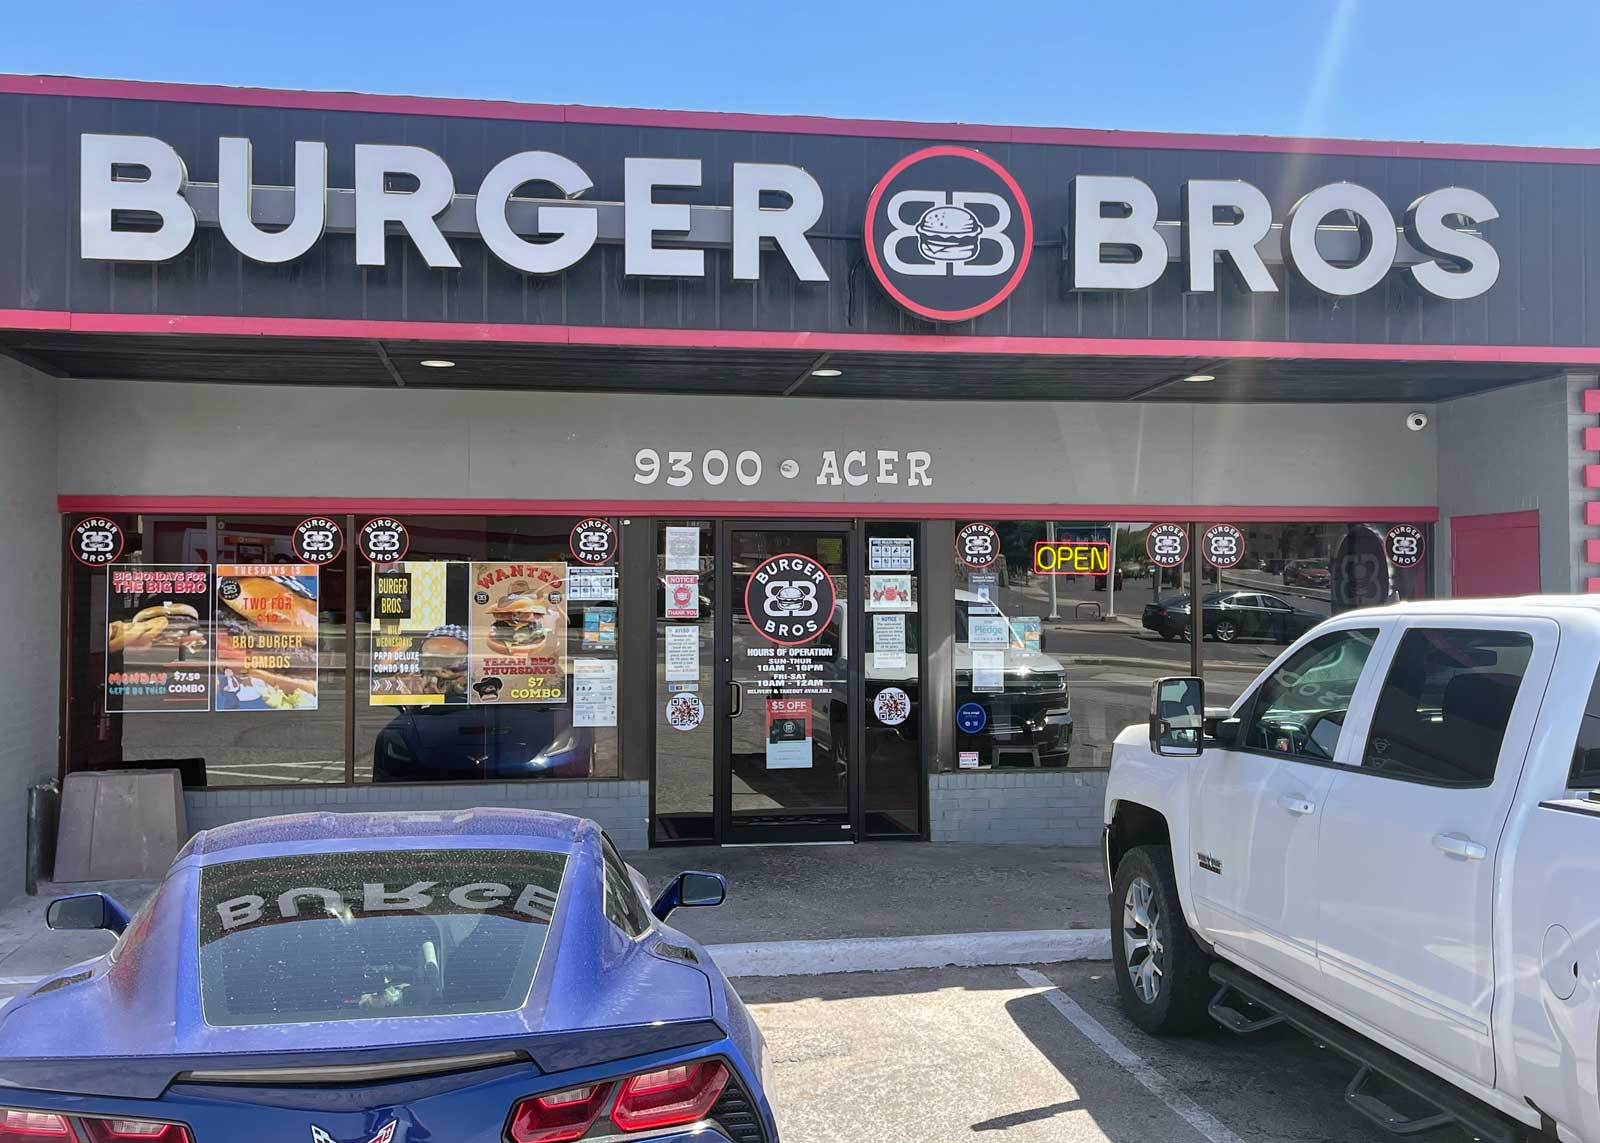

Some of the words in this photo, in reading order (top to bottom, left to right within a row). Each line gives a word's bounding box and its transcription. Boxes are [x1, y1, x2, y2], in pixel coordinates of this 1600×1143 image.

[81, 133, 830, 281] BURGER
[1070, 174, 1500, 300] BROS
[634, 448, 762, 487] 9300
[816, 450, 932, 486] ACER
[77, 520, 117, 534] BURGER
[298, 520, 338, 534] BURGER
[365, 520, 403, 534] BURGER
[576, 521, 612, 535] BURGER
[961, 525, 995, 539] BURGER
[1151, 525, 1184, 538] BURGER
[1207, 526, 1240, 539] BURGER
[1389, 526, 1421, 540] BURGER
[81, 552, 113, 562] BROS
[303, 551, 333, 561] BROS
[369, 551, 399, 561] BROS
[579, 551, 607, 561] BROS
[966, 555, 992, 564] BROS
[1037, 546, 1107, 571] OPEN
[1155, 555, 1181, 564] BROS
[1211, 555, 1237, 564] BROS
[1392, 555, 1417, 564] BROS
[234, 566, 286, 575] TUESDAYS
[755, 559, 825, 585] BURGER
[113, 571, 132, 581] BIG
[133, 571, 184, 581] MONDAYS
[185, 572, 207, 582] FOR
[477, 565, 563, 589] WANTED
[670, 576, 697, 584] NOTICE
[113, 580, 144, 593] THE
[145, 581, 173, 594] BIG
[174, 581, 207, 594] BRO
[378, 578, 408, 594] BURGER
[243, 597, 267, 610] TWO
[271, 597, 292, 610] FOR
[381, 597, 404, 614] BROS.
[387, 625, 401, 635] WILD
[764, 619, 818, 637] BROS
[974, 625, 1002, 637] Pledge
[232, 635, 254, 649] BRO
[258, 634, 303, 649] BURGER
[373, 652, 393, 661] PAPA
[394, 651, 420, 661] DELUXE
[748, 648, 775, 657] HOURS
[777, 648, 786, 656] OF
[789, 648, 833, 657] OPERATION
[244, 655, 291, 669] COMBOS
[483, 657, 527, 667] TEXAN
[373, 664, 398, 673] COMBO
[483, 666, 557, 676] THURSDAYS
[108, 672, 168, 685] MONDAY
[173, 671, 201, 681] $7.50
[528, 677, 544, 688] $7
[168, 684, 206, 693] COMBO
[511, 688, 561, 699] COMBO
[771, 700, 785, 710] $5
[787, 701, 807, 710] OFF
